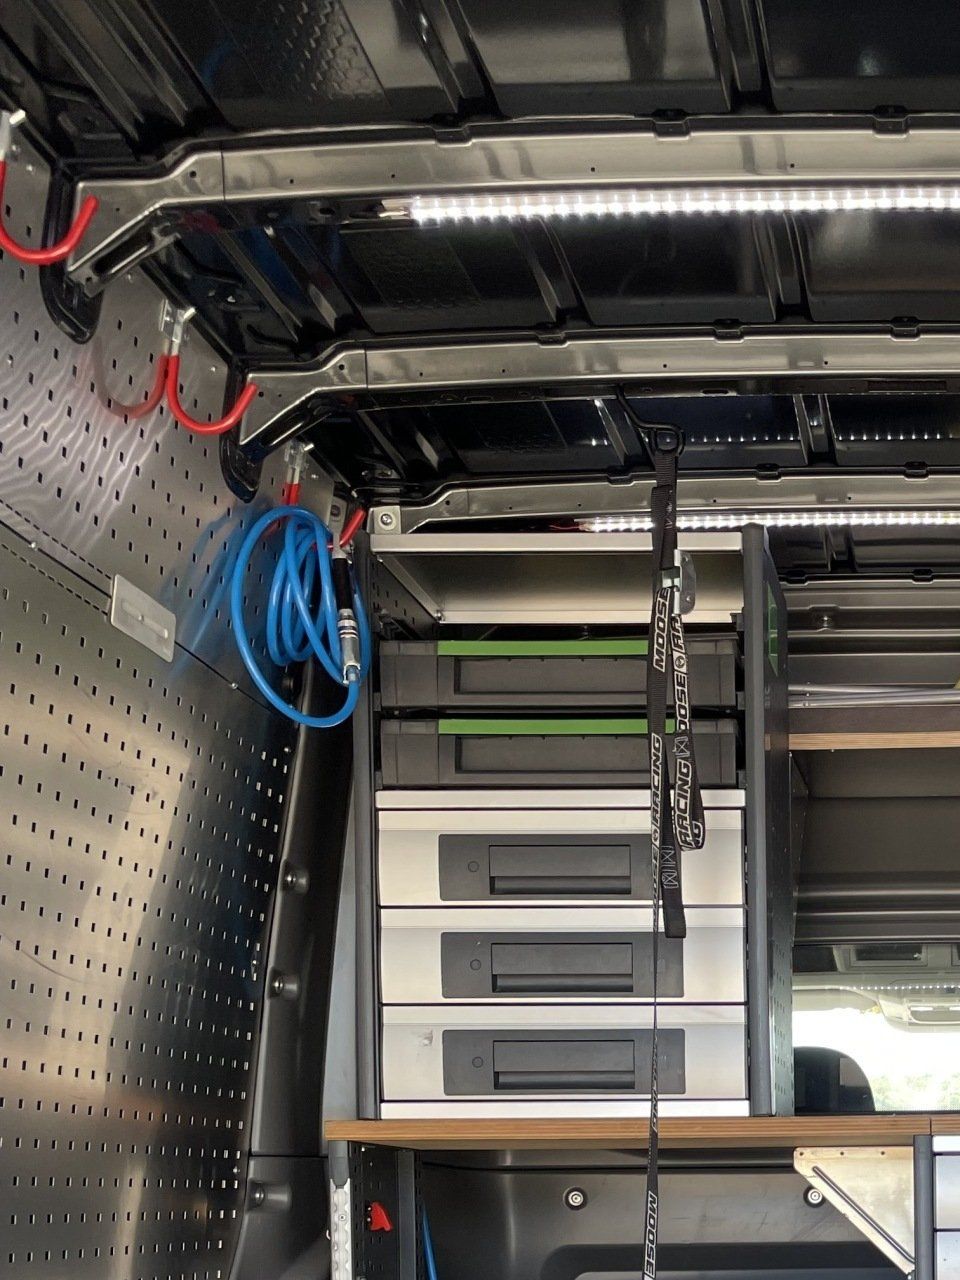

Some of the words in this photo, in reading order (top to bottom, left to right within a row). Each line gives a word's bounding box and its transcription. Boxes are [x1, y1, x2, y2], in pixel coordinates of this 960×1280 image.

[653, 587, 671, 673] MOOSE
[651, 732, 663, 827] RACING
[675, 758, 692, 849] RACING
[644, 1190, 658, 1279] MOOSE
